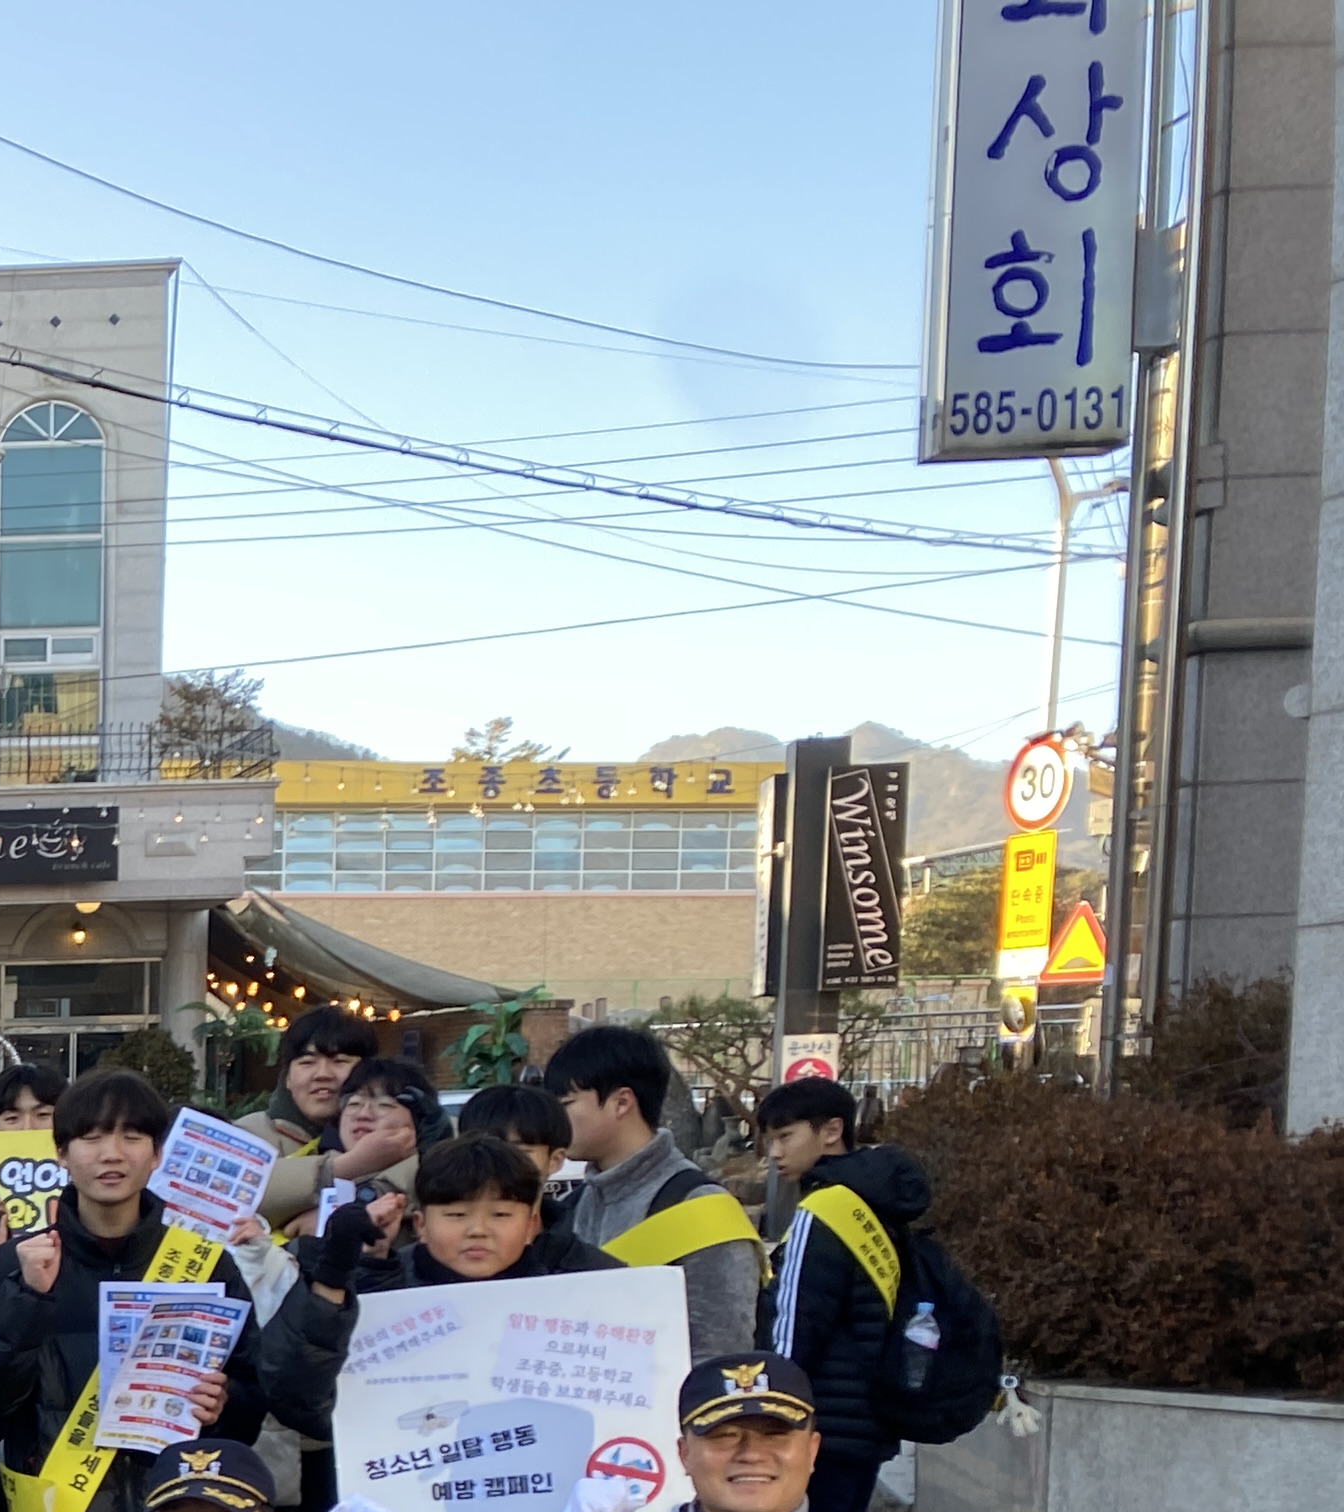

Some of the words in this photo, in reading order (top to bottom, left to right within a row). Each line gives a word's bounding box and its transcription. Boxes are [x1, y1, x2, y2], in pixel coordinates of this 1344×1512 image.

[949, 385, 1125, 435] 585-0131
[418, 766, 735, 799] 조종초등학교
[1021, 762, 1056, 801] 30
[832, 776, 894, 968] Winsome
[544, 1339, 608, 1361] 으로부터
[569, 1364, 634, 1384] 고등학교
[364, 1448, 434, 1482] 청소년
[439, 1435, 485, 1466] 일탈
[489, 1423, 538, 1453] 행동
[431, 1478, 478, 1502] 예방
[484, 1472, 555, 1500] 캠페인
